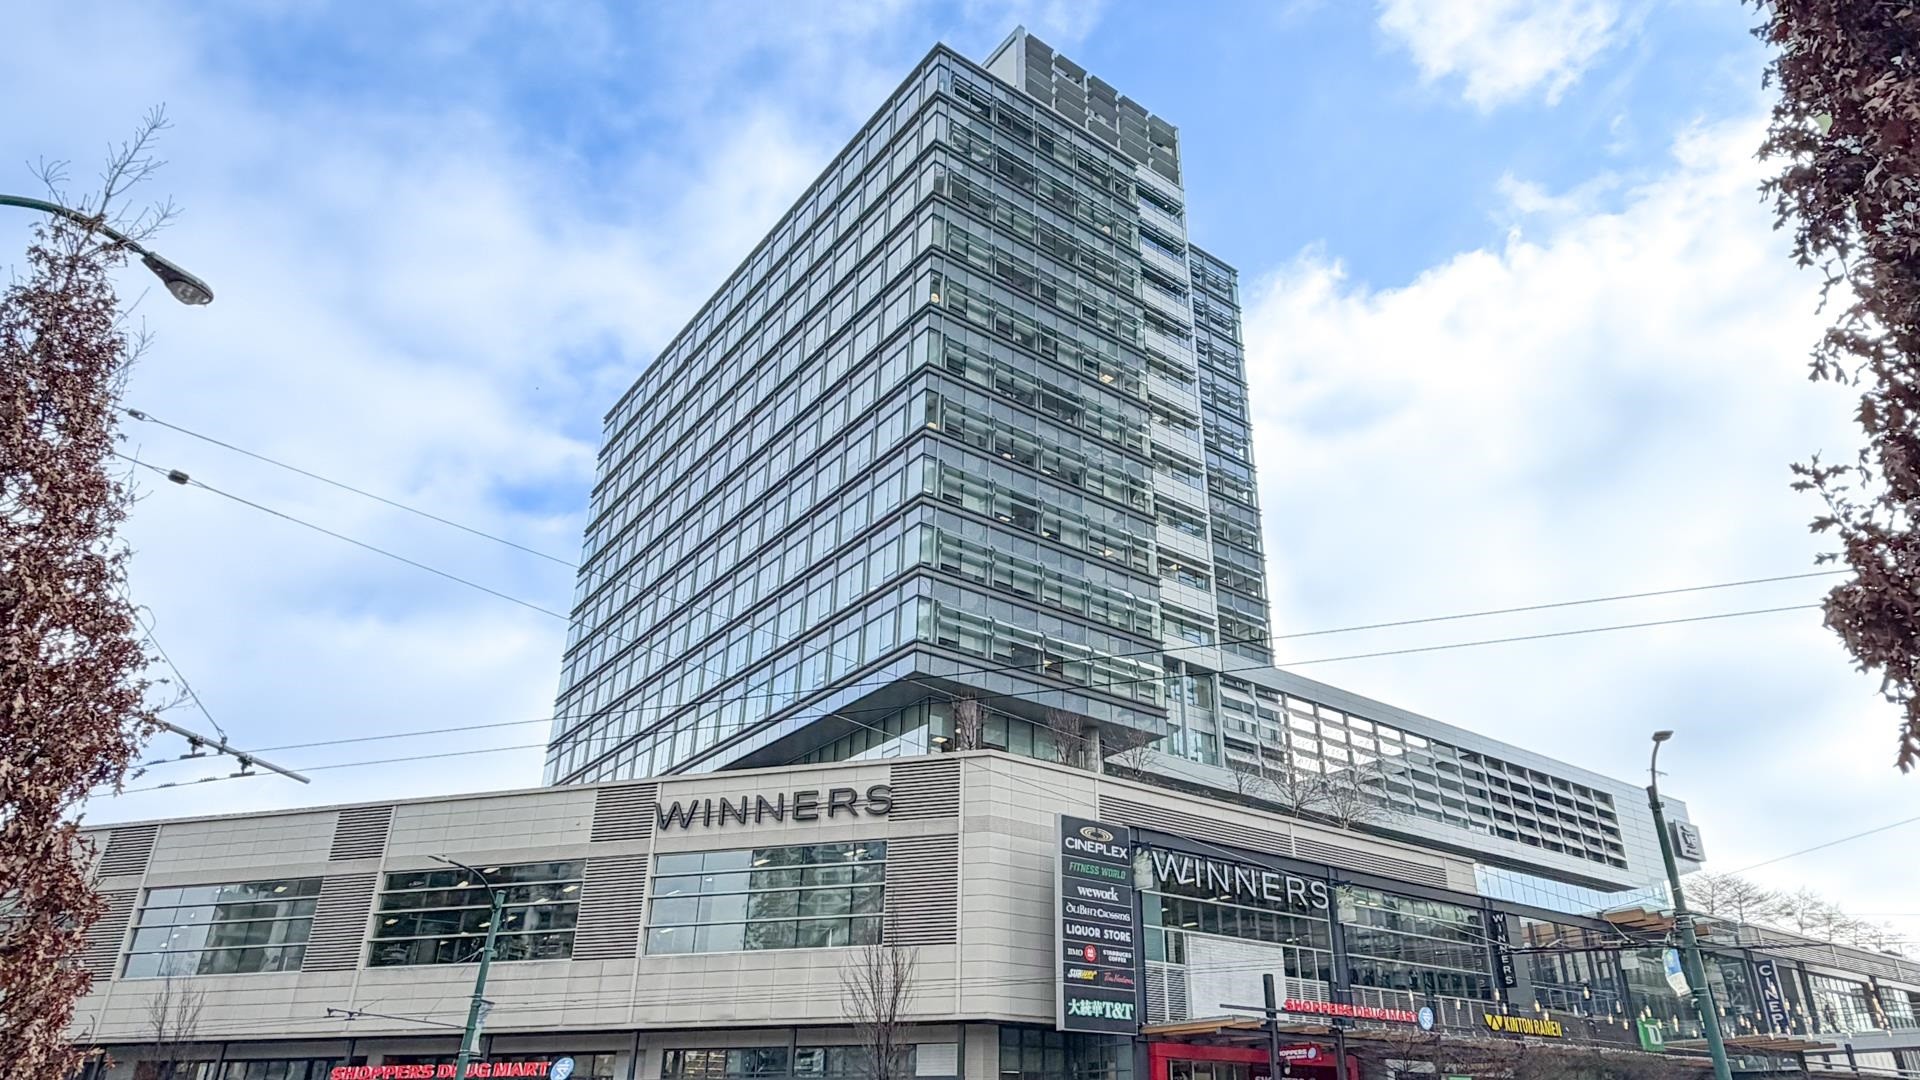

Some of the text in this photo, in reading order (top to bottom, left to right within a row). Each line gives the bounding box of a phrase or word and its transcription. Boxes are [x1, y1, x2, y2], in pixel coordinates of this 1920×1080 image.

[655, 784, 894, 831] WINNERS
[1065, 837, 1128, 860] CINEPLEX
[1069, 862, 1126, 879] FITNESS WORLD
[1152, 851, 1329, 909] WINNERS
[1077, 886, 1119, 901] wework
[1066, 924, 1131, 942] LIQUOR STORE
[1493, 914, 1513, 985] WINNERS
[1285, 998, 1353, 1017] SHOPPERS
[1353, 1005, 1387, 1020] DRUG
[1503, 1016, 1562, 1037] KINTON RAMEN
[331, 1064, 435, 1080] SHOPPERS
[492, 1062, 552, 1077] MART
